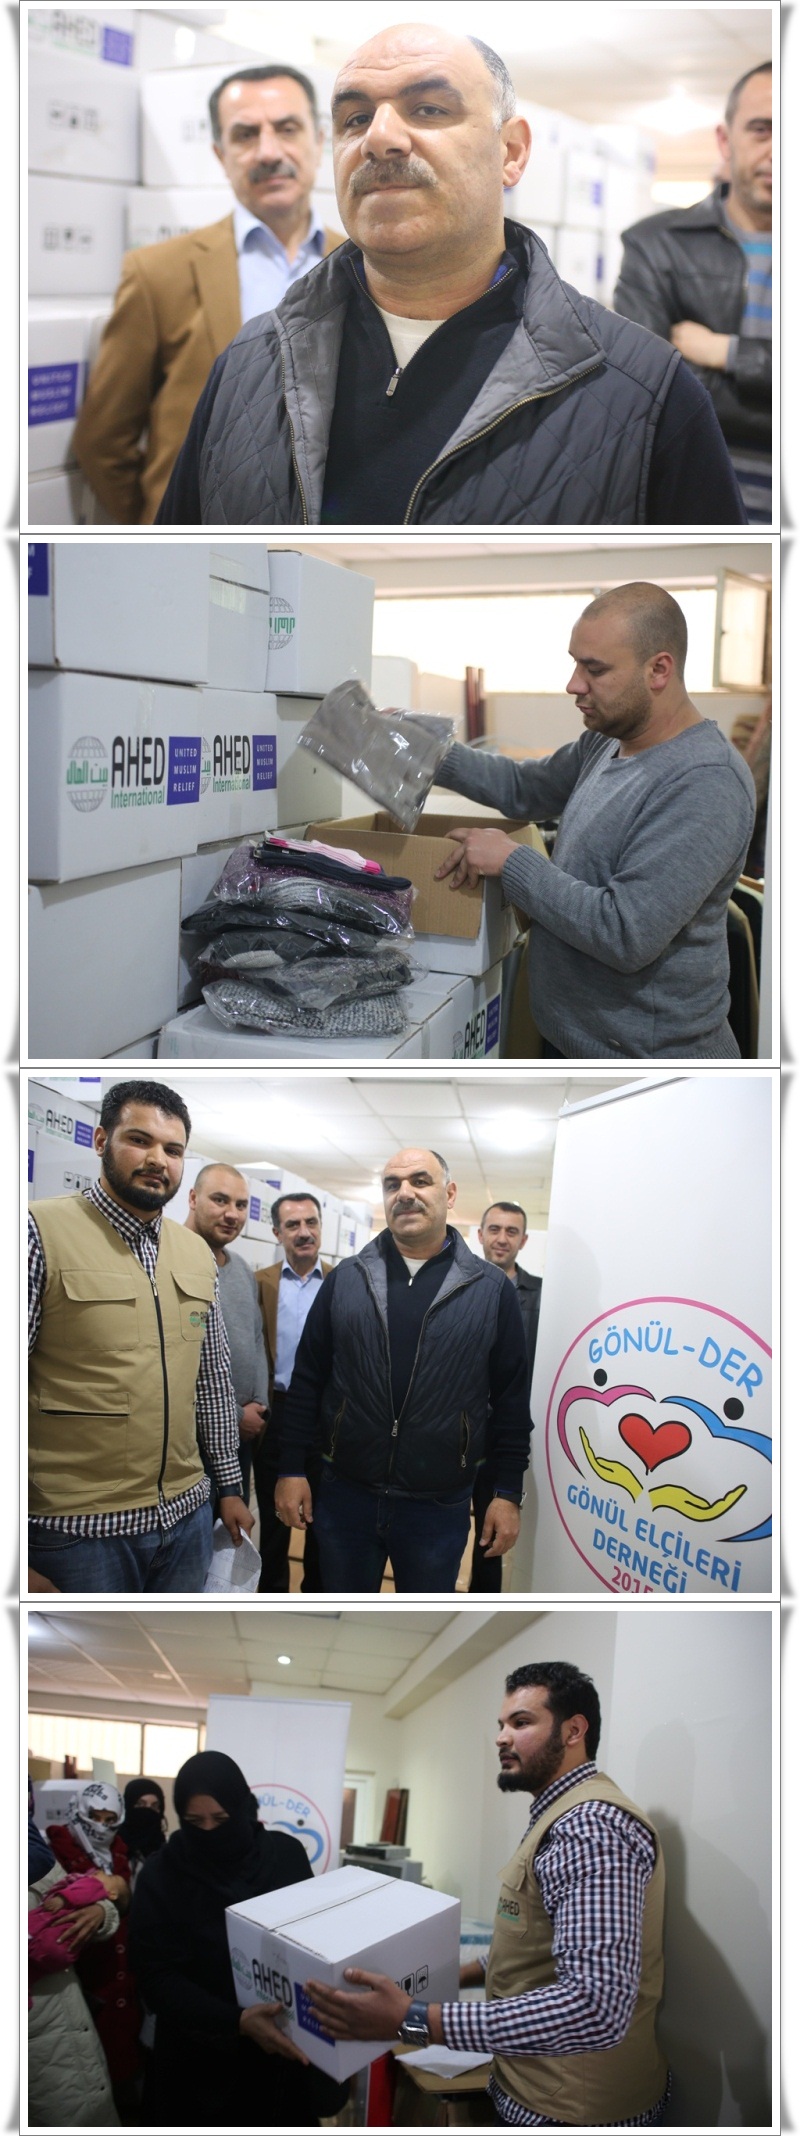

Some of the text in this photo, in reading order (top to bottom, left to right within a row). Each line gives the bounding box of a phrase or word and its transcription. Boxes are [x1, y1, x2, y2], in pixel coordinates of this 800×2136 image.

[174, 748, 198, 758] UNITED
[213, 734, 251, 777] AHED
[256, 744, 273, 752] UNITED
[111, 735, 166, 788] AHED
[173, 765, 197, 775] MUSLIM
[256, 758, 274, 766] MUSLIM
[172, 782, 195, 793] RELIEF
[212, 776, 251, 794] International
[256, 771, 273, 781] RELIEF
[110, 785, 165, 809] International
[464, 1009, 486, 1059] AHED
[46, 1109, 74, 1135] AHED
[588, 1320, 763, 1398] GÖNÜL-DER
[567, 1484, 742, 1593] GÖNÜL ELÇİLERİ
[593, 1528, 688, 1593] DERNEĞİ
[252, 1958, 293, 2008] AHED
